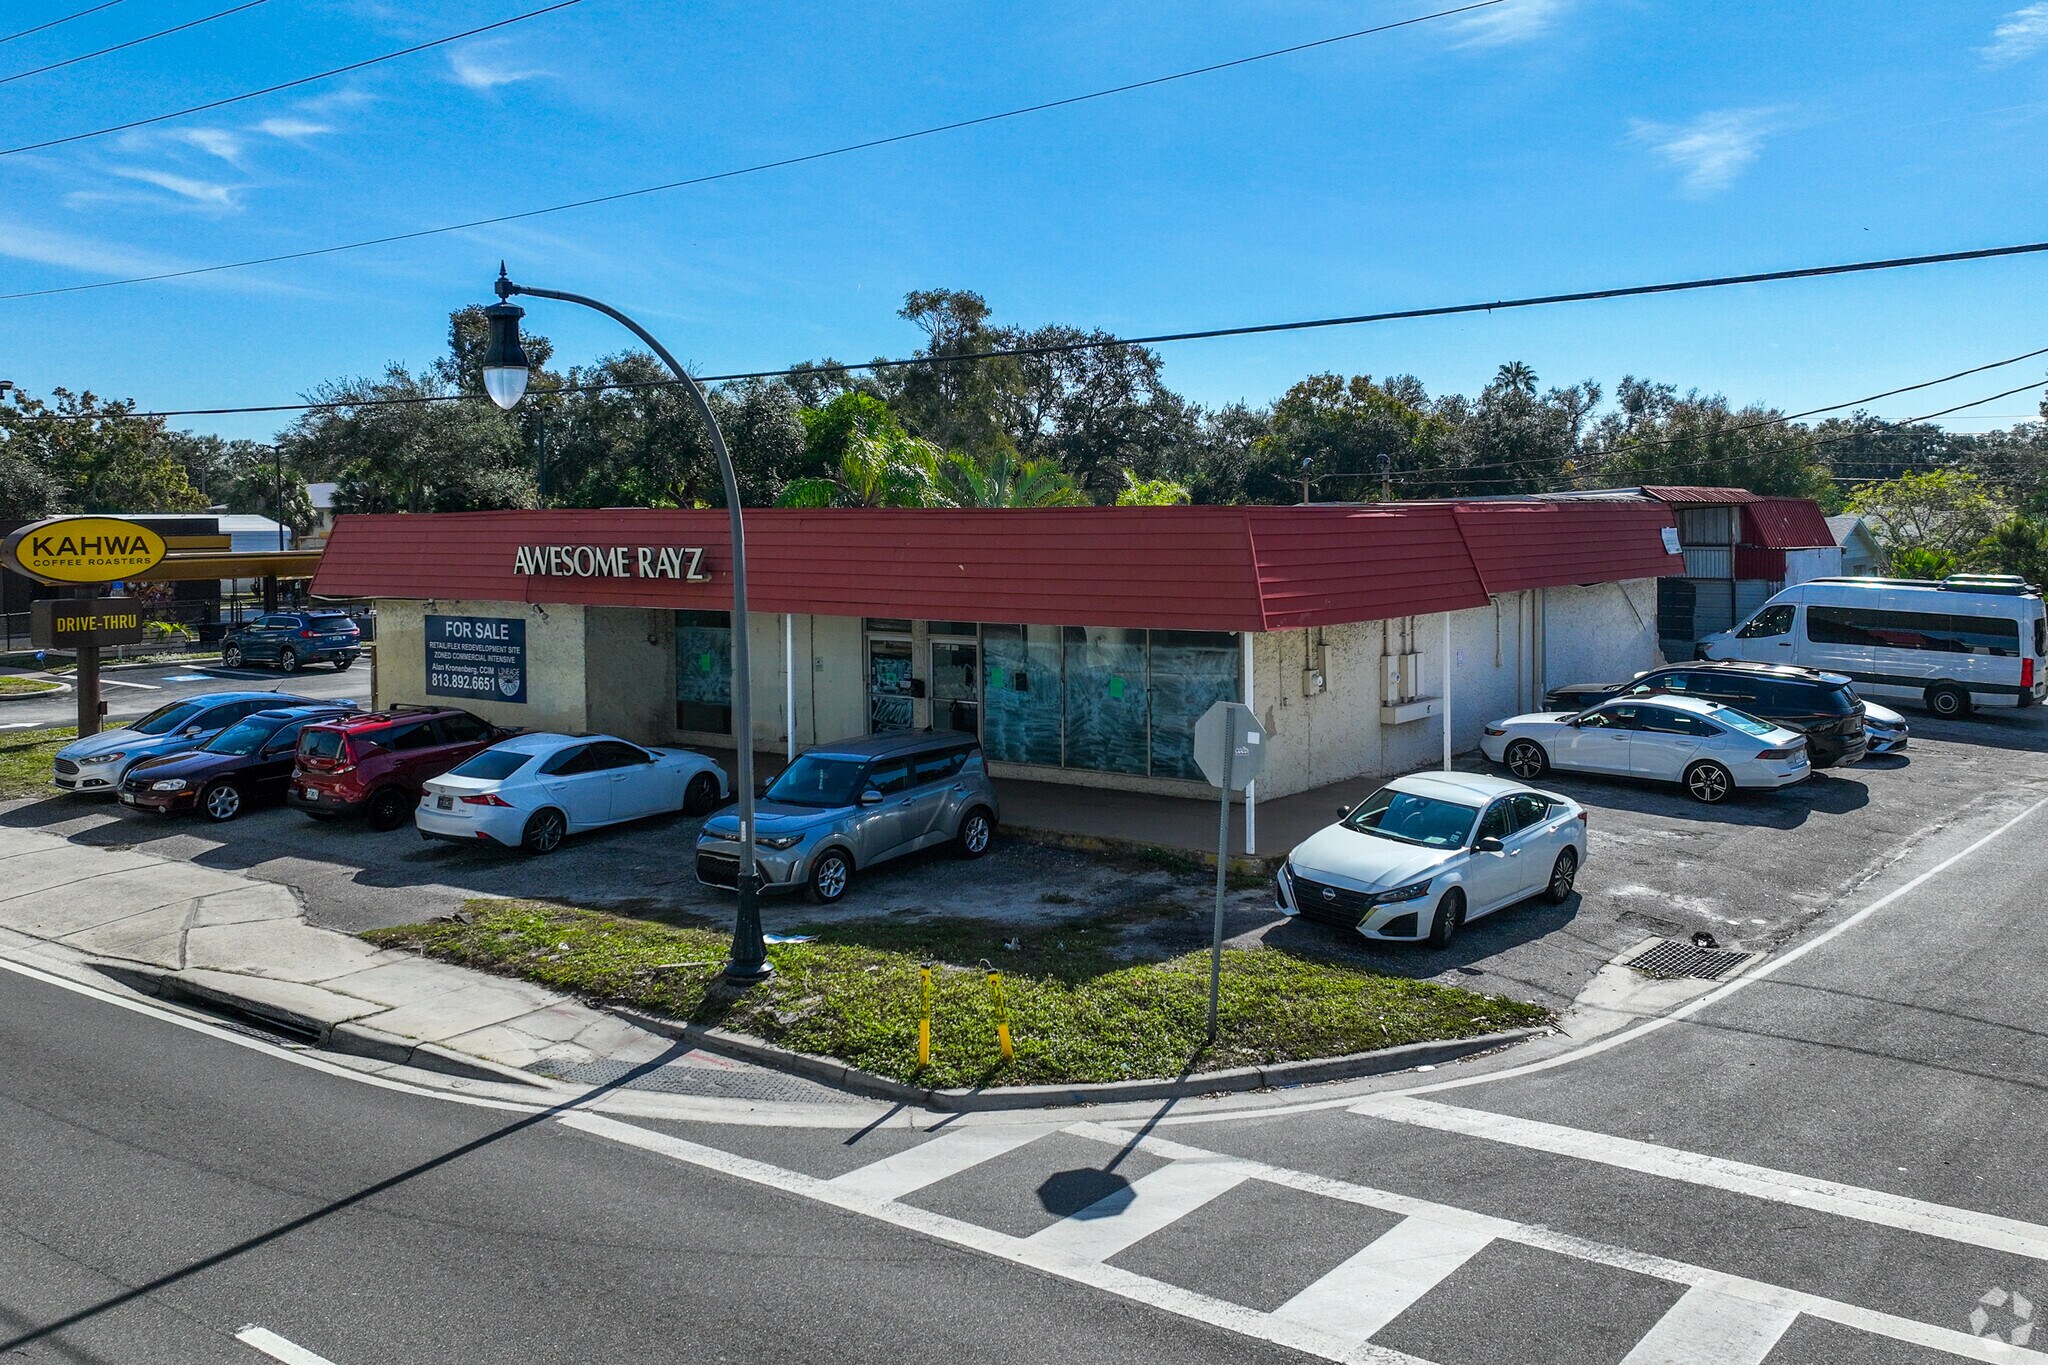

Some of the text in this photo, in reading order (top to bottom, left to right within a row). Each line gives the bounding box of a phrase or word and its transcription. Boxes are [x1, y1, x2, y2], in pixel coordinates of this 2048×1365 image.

[33, 536, 150, 556] KAHWA
[33, 557, 151, 567] COFFEE ROASTERS
[513, 546, 703, 580] AWESOME RAYZ
[57, 614, 137, 632] DRIVE-THRU
[445, 621, 509, 640] FOR SALE
[429, 641, 520, 654] RETAIL/FLEX REDEVELOPMENT SITE
[434, 651, 451, 659] ZONED
[452, 652, 487, 661] COMMERCIAL
[432, 662, 444, 670] Alan
[480, 666, 494, 674] CCIM
[432, 673, 495, 691] 813.892.6651
